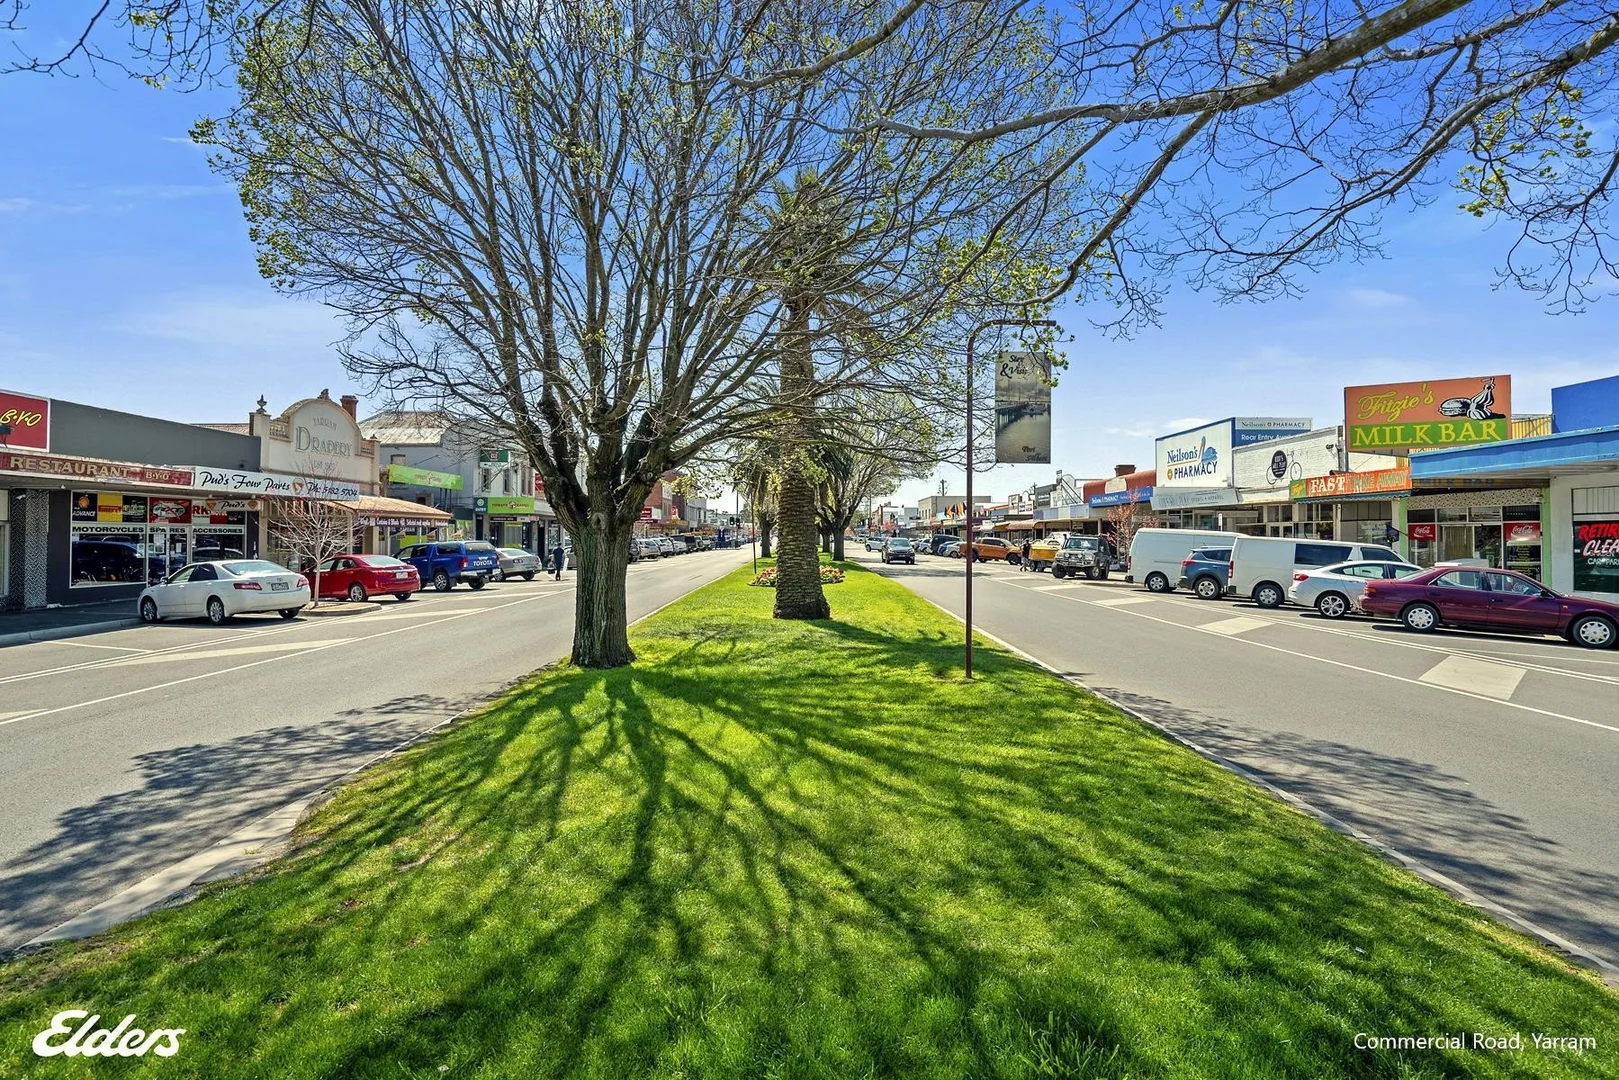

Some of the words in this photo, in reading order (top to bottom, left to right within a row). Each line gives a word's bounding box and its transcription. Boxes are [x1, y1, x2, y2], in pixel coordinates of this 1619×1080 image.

[1000, 363, 1012, 379] &
[1357, 383, 1434, 422] Fitzie's
[295, 425, 352, 457] DRAPERY
[1352, 424, 1433, 446] MILK
[1438, 420, 1502, 442] BAR
[1167, 446, 1198, 464] Neilson's
[10, 456, 130, 478] RESTAURANT
[1174, 461, 1218, 480] PHARMACY
[199, 471, 229, 487] Pud's
[231, 474, 261, 490] Four
[262, 478, 290, 492] Parts
[1310, 476, 1345, 493] FAST
[1349, 474, 1375, 489] TAKE
[1377, 471, 1409, 487] AWAY
[217, 500, 245, 510] Pud's
[473, 559, 493, 567] TOYOTA
